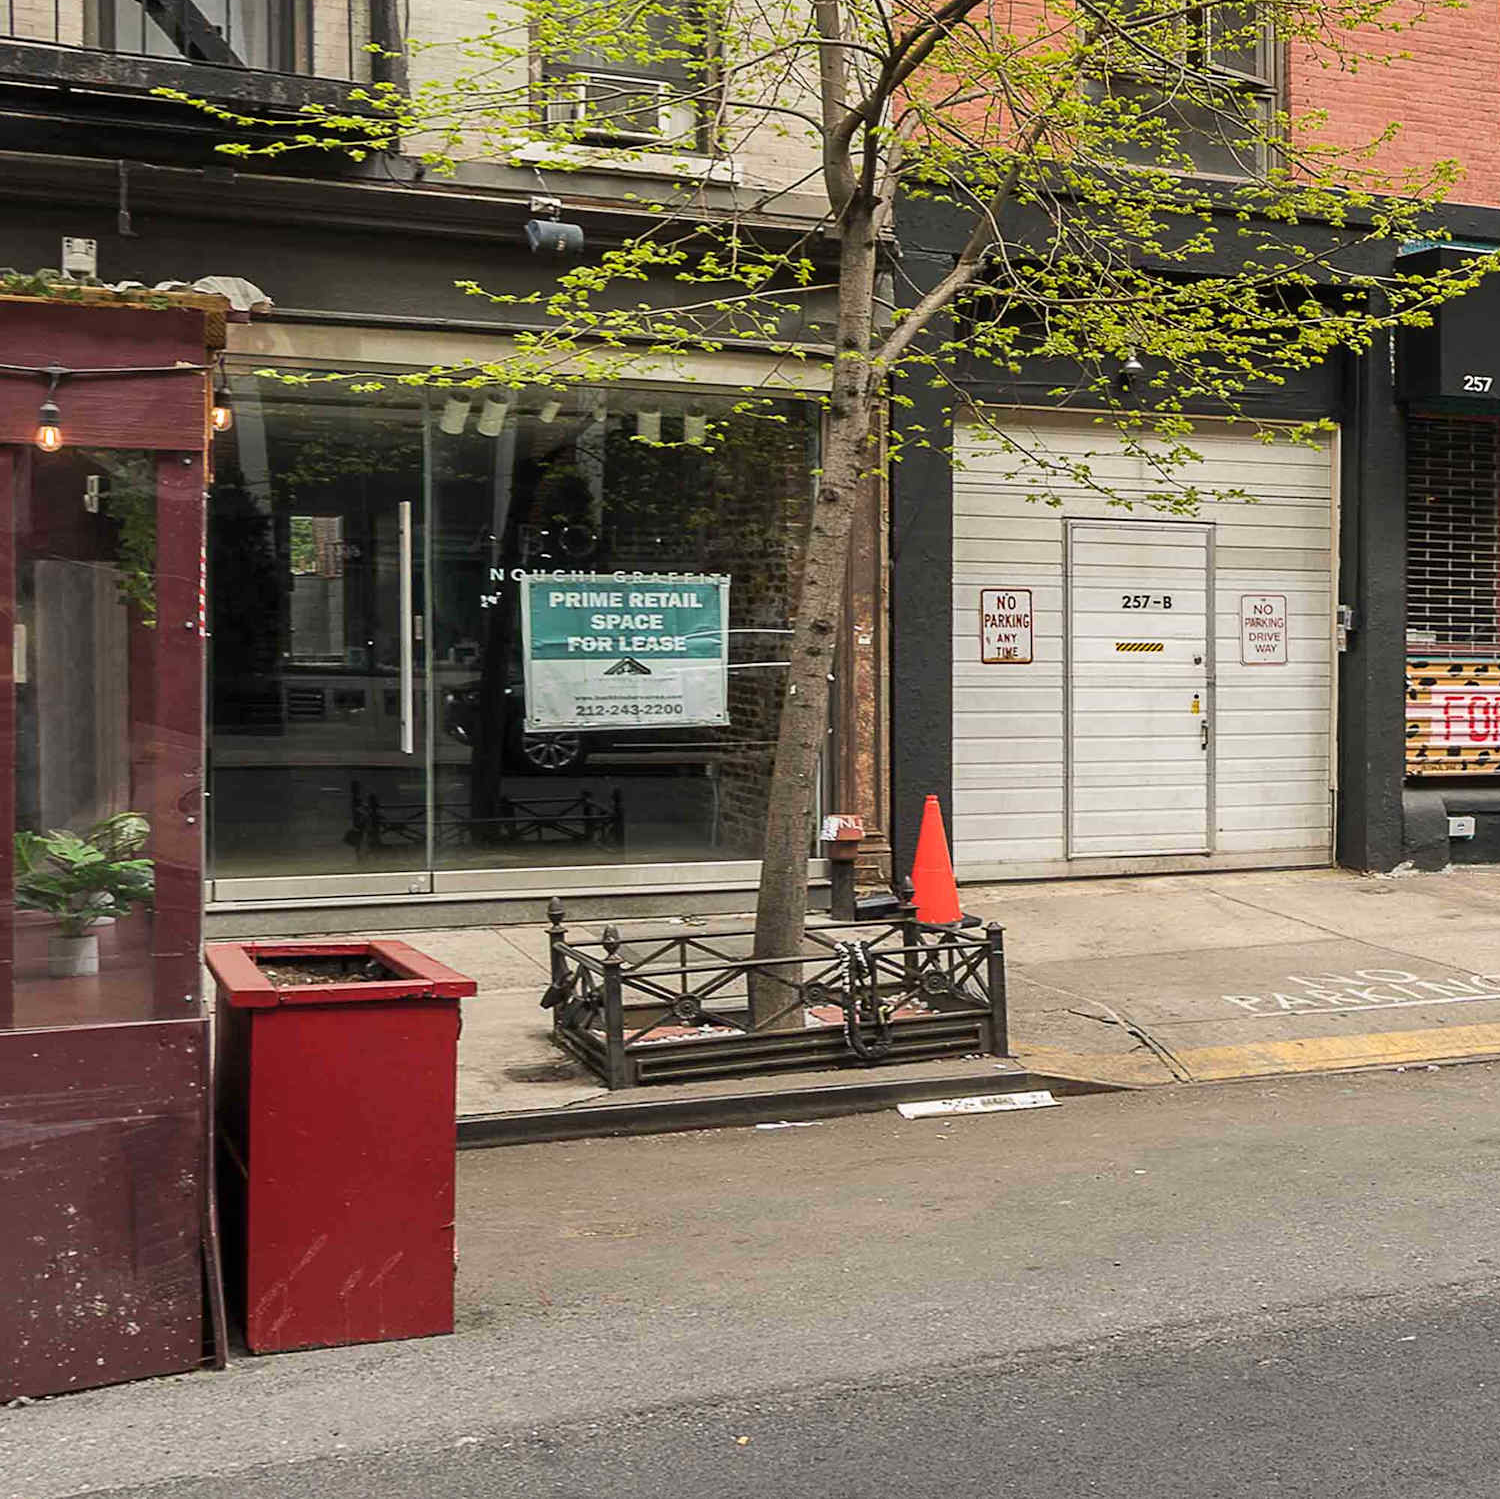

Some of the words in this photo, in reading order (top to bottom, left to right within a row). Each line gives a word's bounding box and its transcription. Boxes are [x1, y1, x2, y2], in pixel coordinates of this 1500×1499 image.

[1463, 375, 1494, 392] 257
[550, 592, 623, 608] PRIME
[628, 592, 703, 608] RETAIL
[996, 595, 1017, 611] NO
[1122, 595, 1172, 610] 257-B
[1253, 604, 1273, 616] NO
[590, 614, 664, 630] SPACE
[984, 613, 1030, 629] PARKING
[1245, 617, 1284, 629] PARKING
[568, 636, 614, 652] FOR
[619, 636, 688, 652] LEASE
[996, 633, 1018, 644] ANY
[1248, 632, 1281, 642] DRIVE
[996, 646, 1019, 658] TIME
[1255, 644, 1278, 654] WAY
[576, 704, 683, 716] 212-243-2200
[1287, 968, 1419, 989] NO
